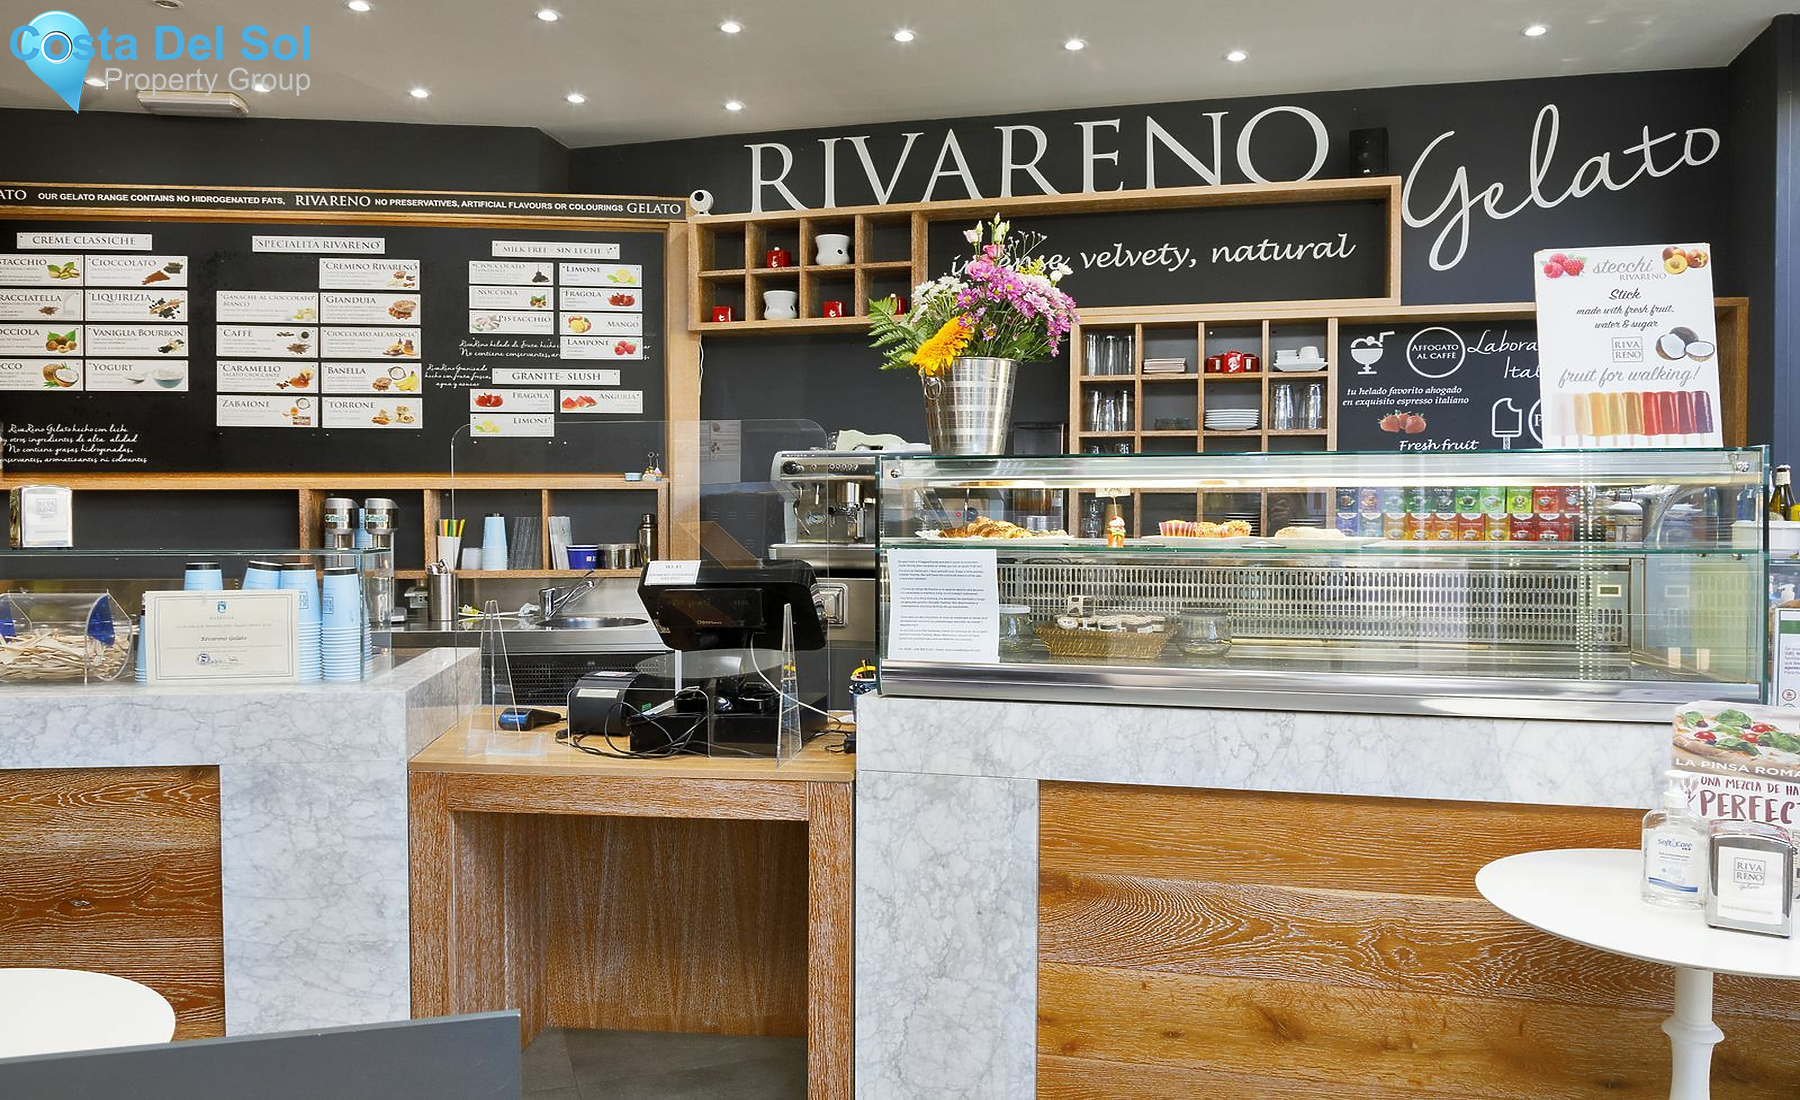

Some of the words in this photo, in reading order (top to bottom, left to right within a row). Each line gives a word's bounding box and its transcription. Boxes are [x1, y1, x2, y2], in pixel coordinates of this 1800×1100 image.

[744, 105, 1330, 213] RIVARENO
[1401, 104, 1720, 271] Gelato
[38, 192, 58, 200] OUR
[60, 193, 95, 201] GELATO
[97, 193, 128, 201] RANGE
[130, 194, 175, 202] CONTAINS
[176, 195, 190, 203] NO
[191, 196, 260, 204] HIDROGENATED
[296, 195, 371, 207] RIVARENO
[389, 198, 460, 208] PRESERVATIVES,
[461, 200, 507, 208] ARTIFICIAL
[508, 202, 553, 210] FLAVOURS
[568, 203, 623, 212] COLOURINGS
[626, 202, 681, 215] GELATO
[73, 236, 135, 245] CLASSICHE
[323, 240, 380, 249] RIVARENO
[1080, 243, 1197, 272] velvety,
[1211, 233, 1357, 263] natural
[91, 258, 157, 267] CIOCCOLATO
[325, 262, 370, 271] CREMINO
[1593, 256, 1654, 275] stecchi
[1619, 273, 1667, 281] RIVARENO
[91, 293, 152, 302] LIQUIRIZIA
[1609, 287, 1642, 301] Stick
[1576, 304, 1602, 315] made
[1603, 305, 1623, 315] with
[1624, 304, 1649, 317] fresh
[1594, 320, 1621, 329] water
[1622, 319, 1630, 328] &
[1630, 321, 1659, 331] sugar
[92, 328, 136, 337] VANIGLIA
[138, 329, 184, 338] BOURBON
[1412, 344, 1459, 352] AFFOGATO
[1614, 341, 1641, 349] RIVA
[1615, 351, 1642, 359] RENO
[92, 363, 133, 372] YOGURT
[222, 364, 281, 372] CARAMELLO
[567, 372, 602, 381] SLUSH
[1558, 367, 1598, 389] fruit
[1599, 368, 1625, 389] for
[1628, 366, 1701, 387] walking!
[1347, 388, 1357, 396] tu
[1358, 387, 1387, 396] helado
[1387, 387, 1424, 397] favorito
[1425, 386, 1462, 395] ahogado
[328, 401, 375, 409] TORRONE
[1355, 398, 1395, 408] exquisito
[1396, 398, 1433, 406] espresso
[1435, 396, 1469, 404] italiano
[1400, 439, 1440, 451] Fresh
[1441, 438, 1480, 451] fruit
[1675, 758, 1696, 767] LA
[1701, 760, 1750, 773] PINSA
[1700, 776, 1721, 787] UNA
[1725, 778, 1763, 792] MEZCLA
[1767, 783, 1781, 794] DE
[1786, 785, 1800, 796] HA
[1737, 861, 1763, 872] RIVA
[1736, 872, 1764, 881] RENO
